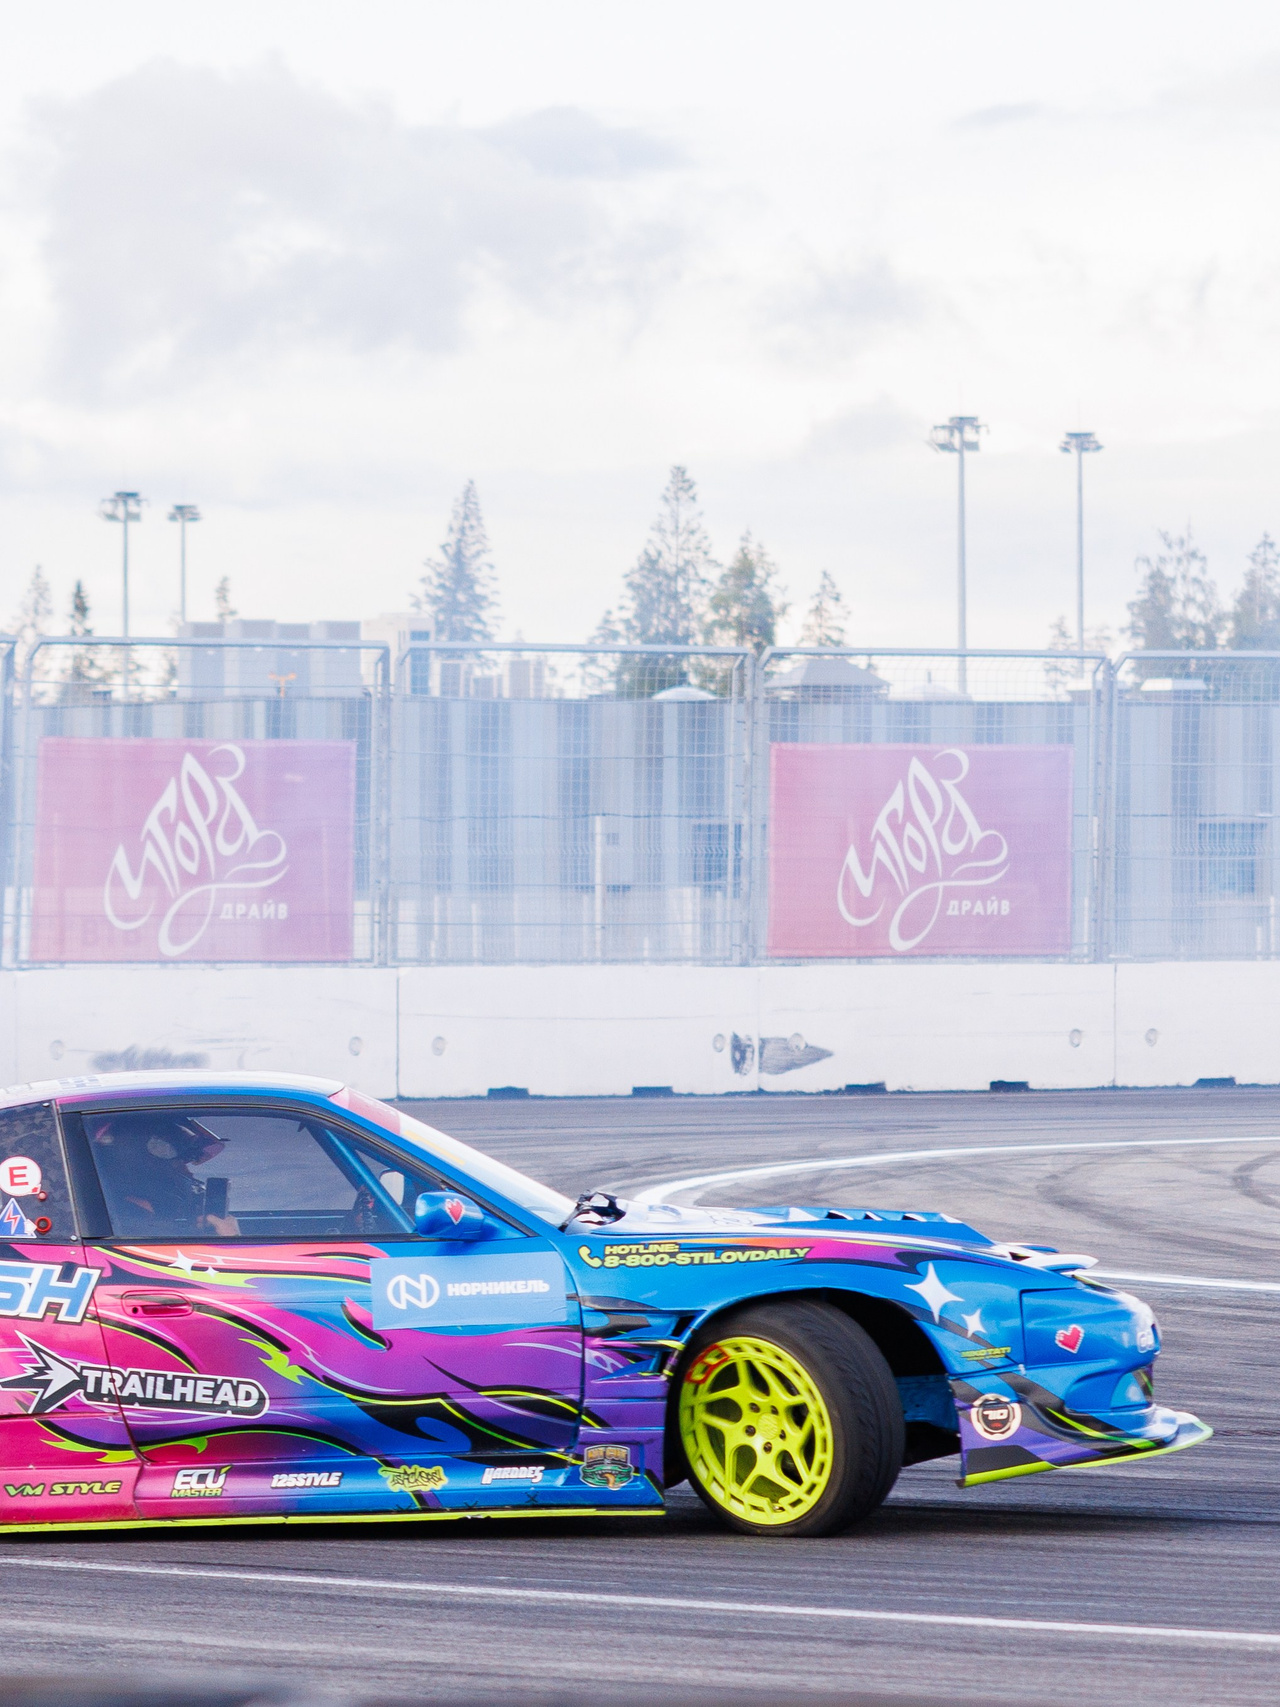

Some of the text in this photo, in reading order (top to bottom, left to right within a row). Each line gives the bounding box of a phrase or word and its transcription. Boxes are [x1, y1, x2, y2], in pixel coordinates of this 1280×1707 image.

[219, 899, 288, 920] ДРАЙВ
[946, 896, 1011, 916] ДРАЙВ
[9, 1165, 29, 1187] E
[604, 1247, 810, 1268] 8-800-STILOVDAILY
[605, 1244, 679, 1255] HOTLINE:
[447, 1279, 550, 1297] НОРНИКЕЛЬ
[82, 1369, 260, 1408] TRAILHEAD
[173, 1466, 230, 1489] ECU
[271, 1472, 342, 1488] 125STYLE
[4, 1481, 122, 1496] VM STYLE
[171, 1488, 223, 1498] MASTER
